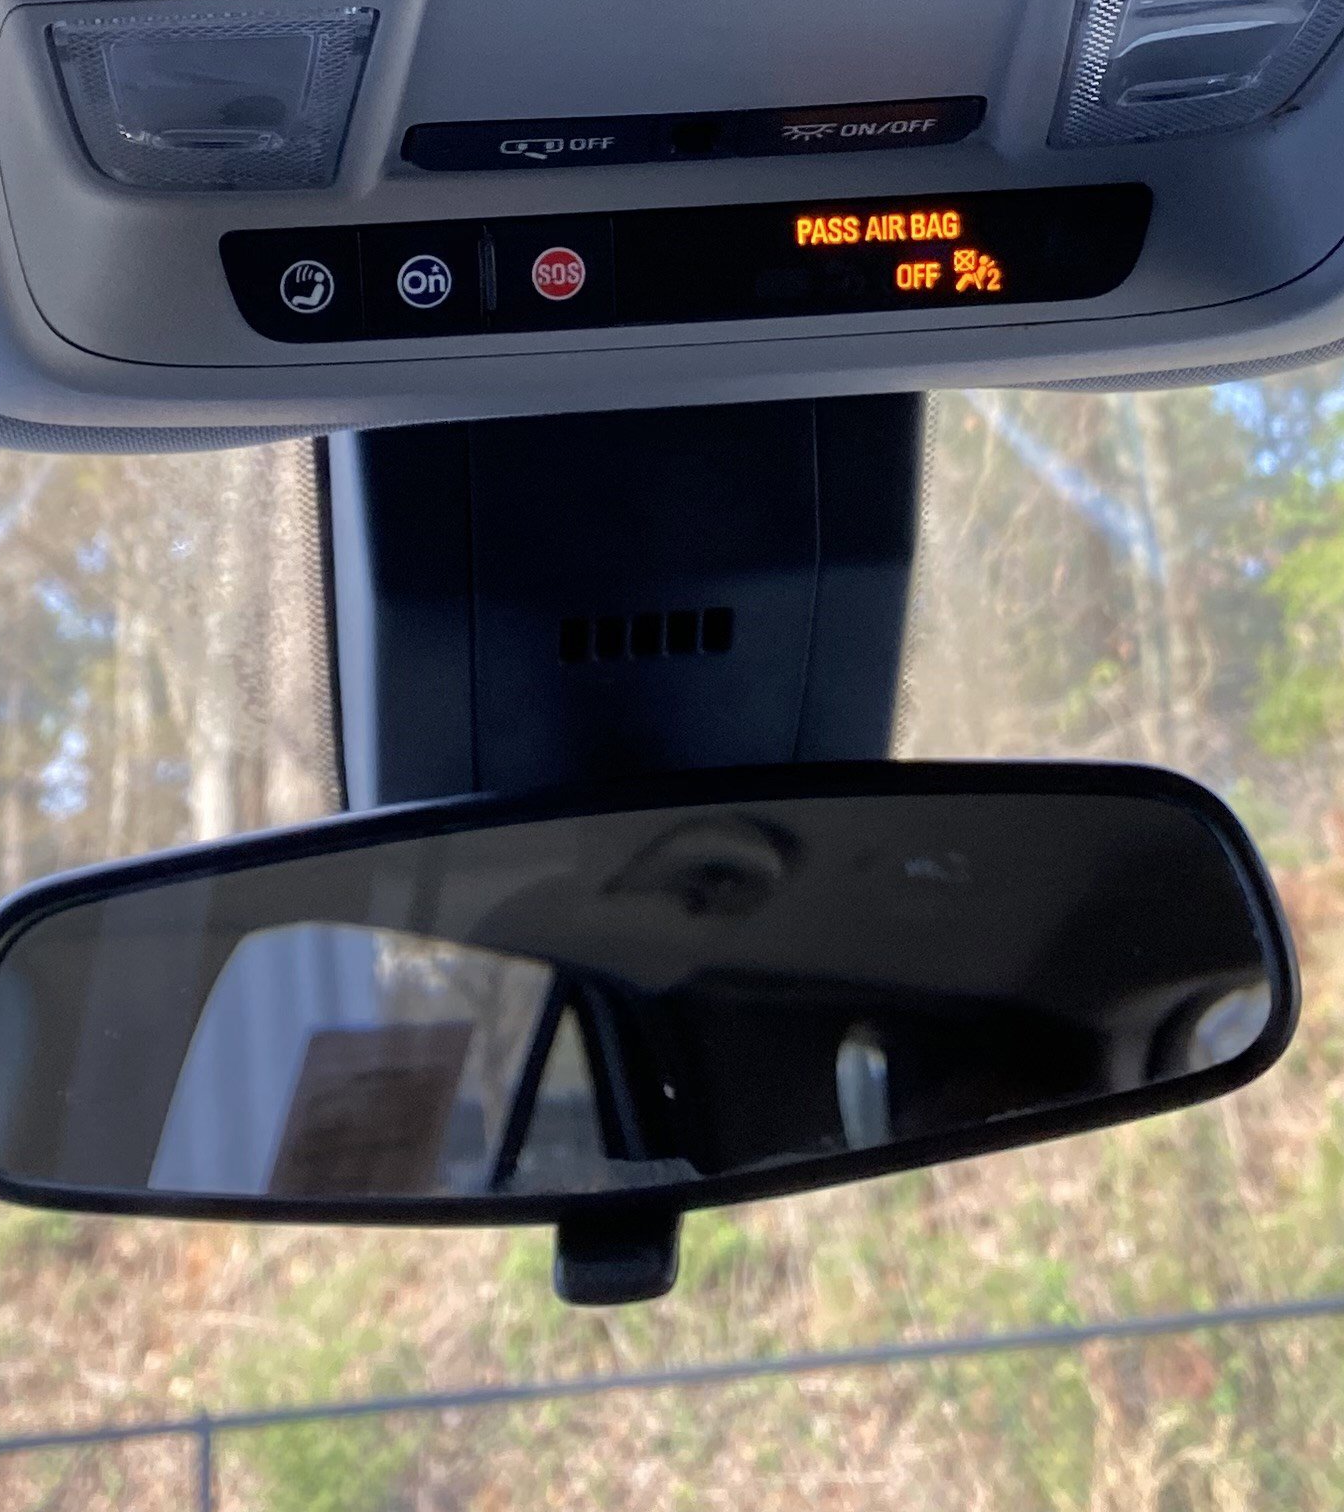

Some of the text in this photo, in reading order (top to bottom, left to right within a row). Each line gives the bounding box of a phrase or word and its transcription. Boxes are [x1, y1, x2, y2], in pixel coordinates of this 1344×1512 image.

[840, 118, 938, 137] ON/OFF
[569, 136, 615, 151] OFF
[796, 210, 960, 246] PASS AIR BAG
[403, 268, 446, 295] On
[537, 262, 581, 286] SOS
[896, 262, 941, 289] OFF
